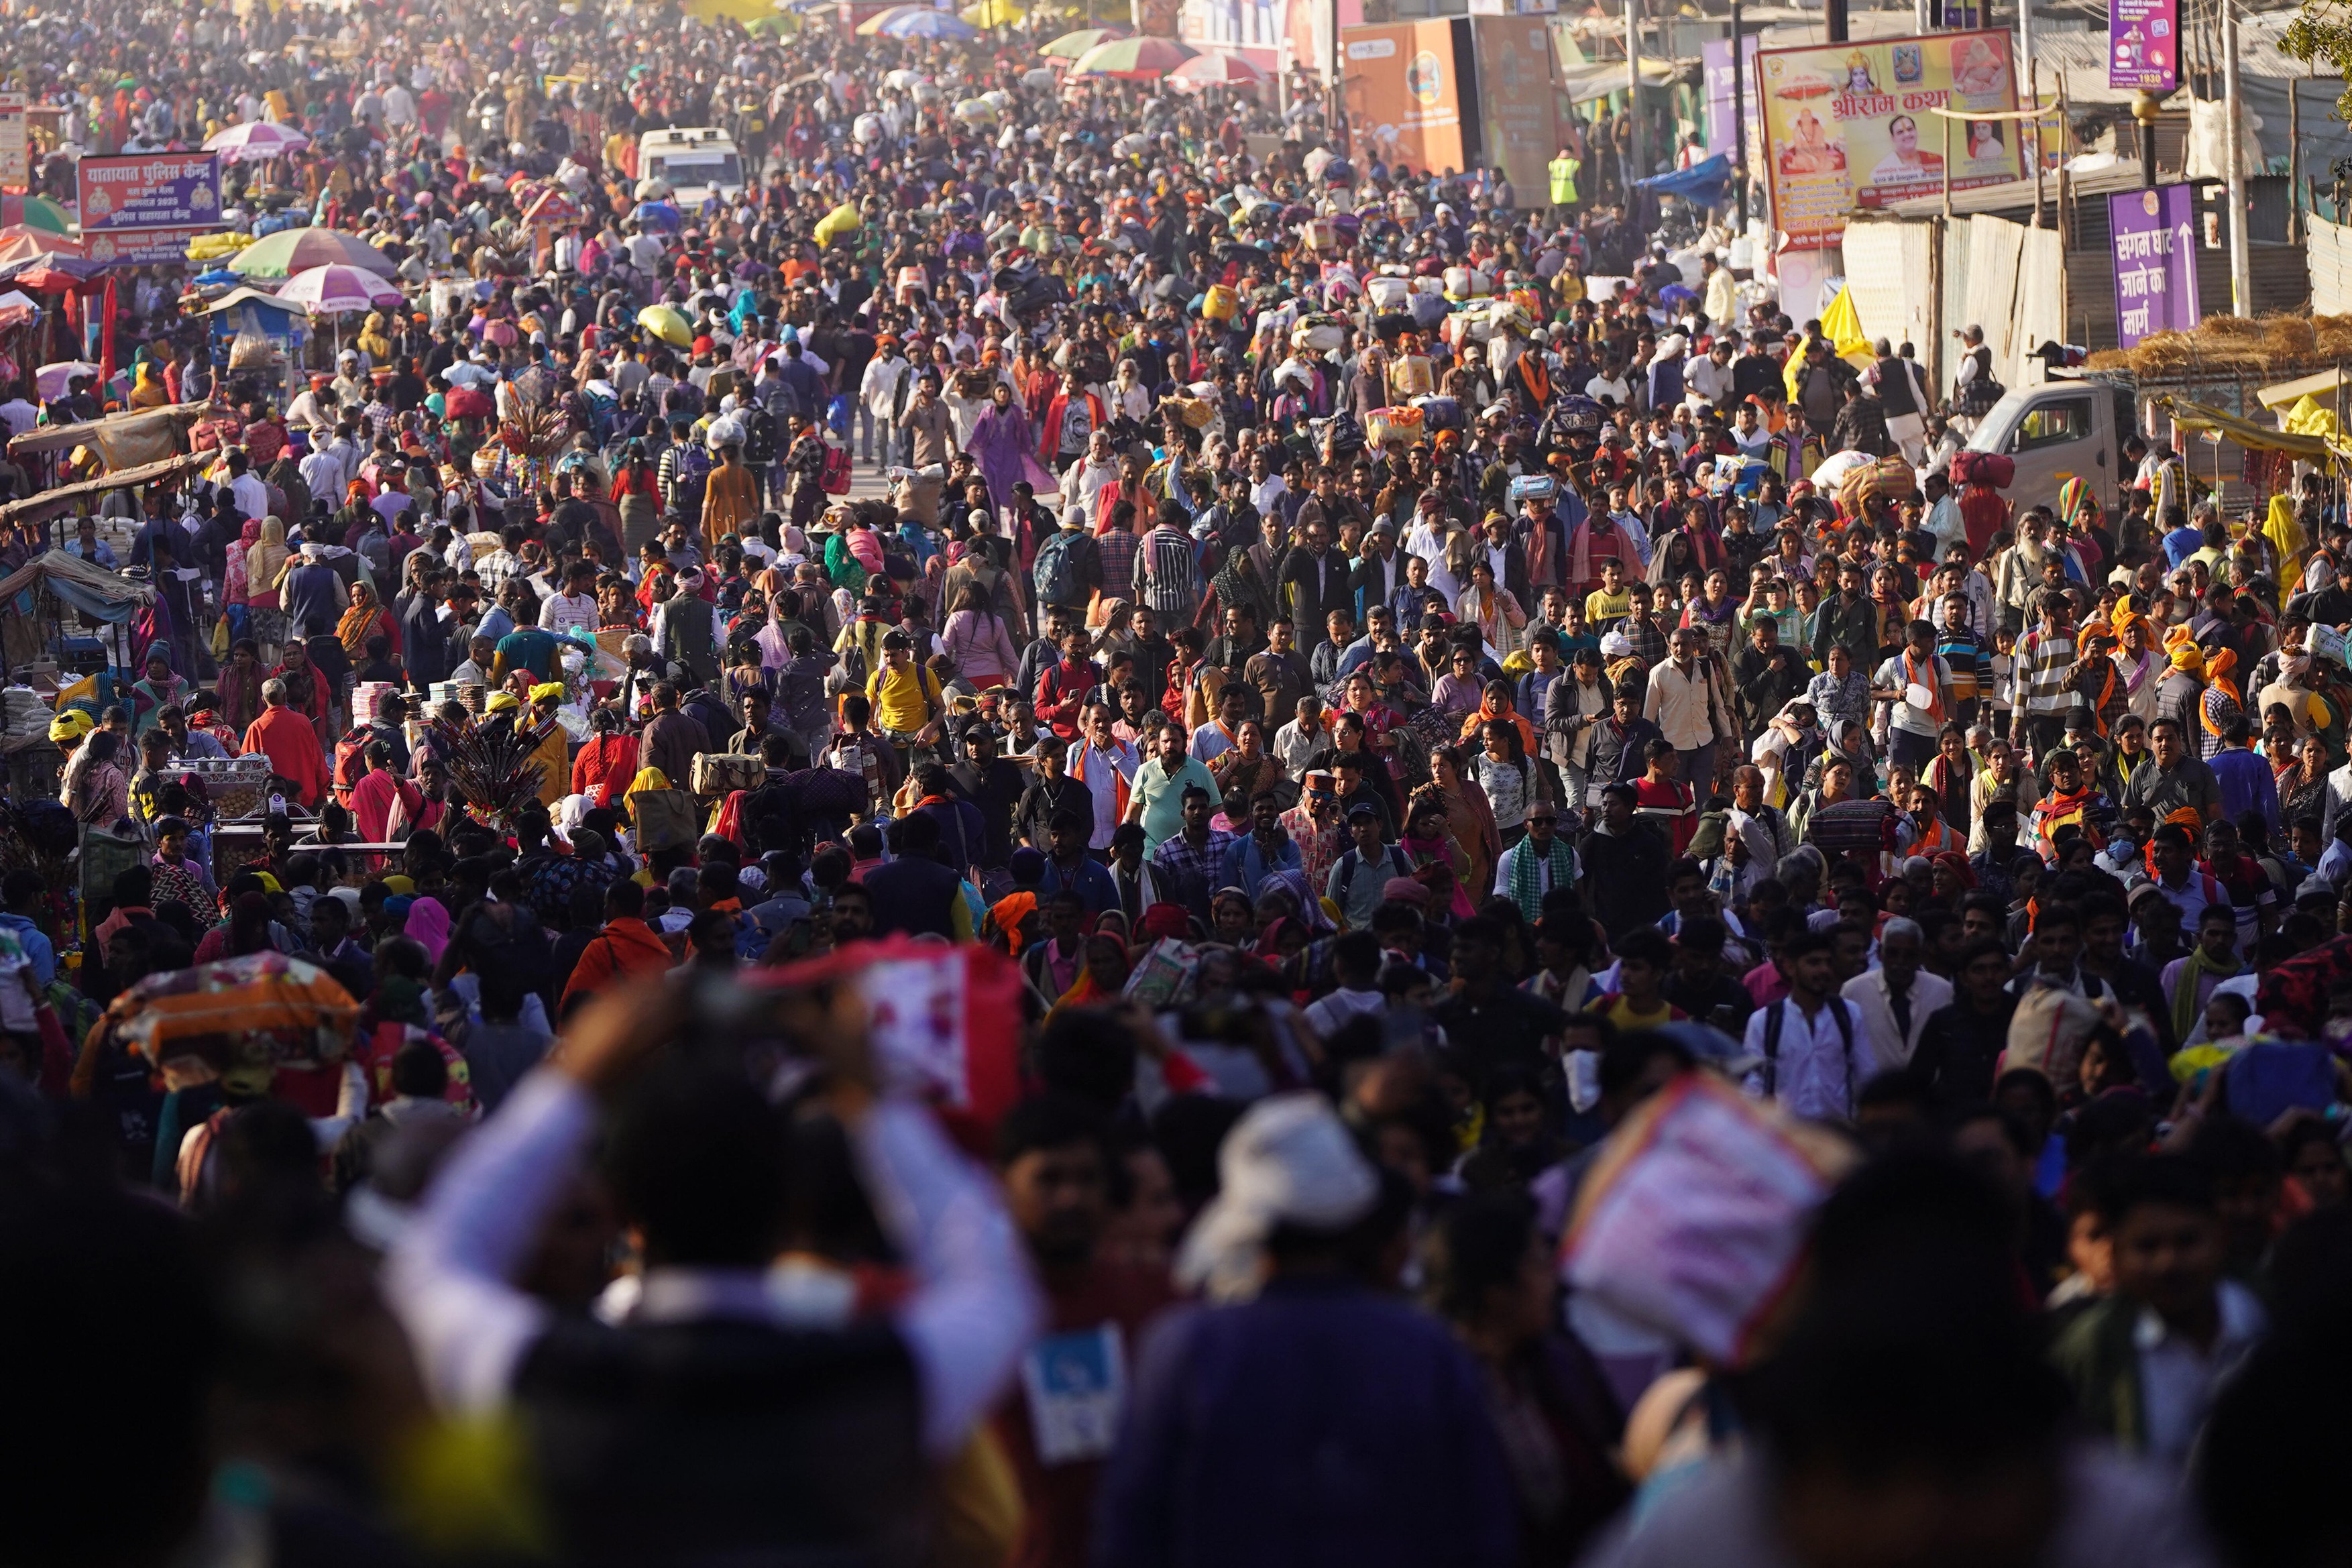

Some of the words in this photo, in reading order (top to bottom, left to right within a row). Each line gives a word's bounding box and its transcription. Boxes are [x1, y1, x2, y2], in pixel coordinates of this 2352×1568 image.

[2139, 74, 2162, 83] 1930
[1832, 93, 1896, 121] श्रीराम
[1903, 90, 1951, 113] कथा
[87, 166, 139, 182] यातायात
[143, 161, 180, 186] पुलिस
[156, 197, 178, 207] 2025
[111, 209, 136, 226] पुलिस
[137, 211, 170, 221] सहायता
[2115, 227, 2151, 261] संगम
[2150, 227, 2174, 256] घाट
[2119, 262, 2148, 298] जाने
[2148, 266, 2166, 293] का
[2121, 299, 2149, 336] मार्ग
[1560, 412, 1599, 429] राजश्री
